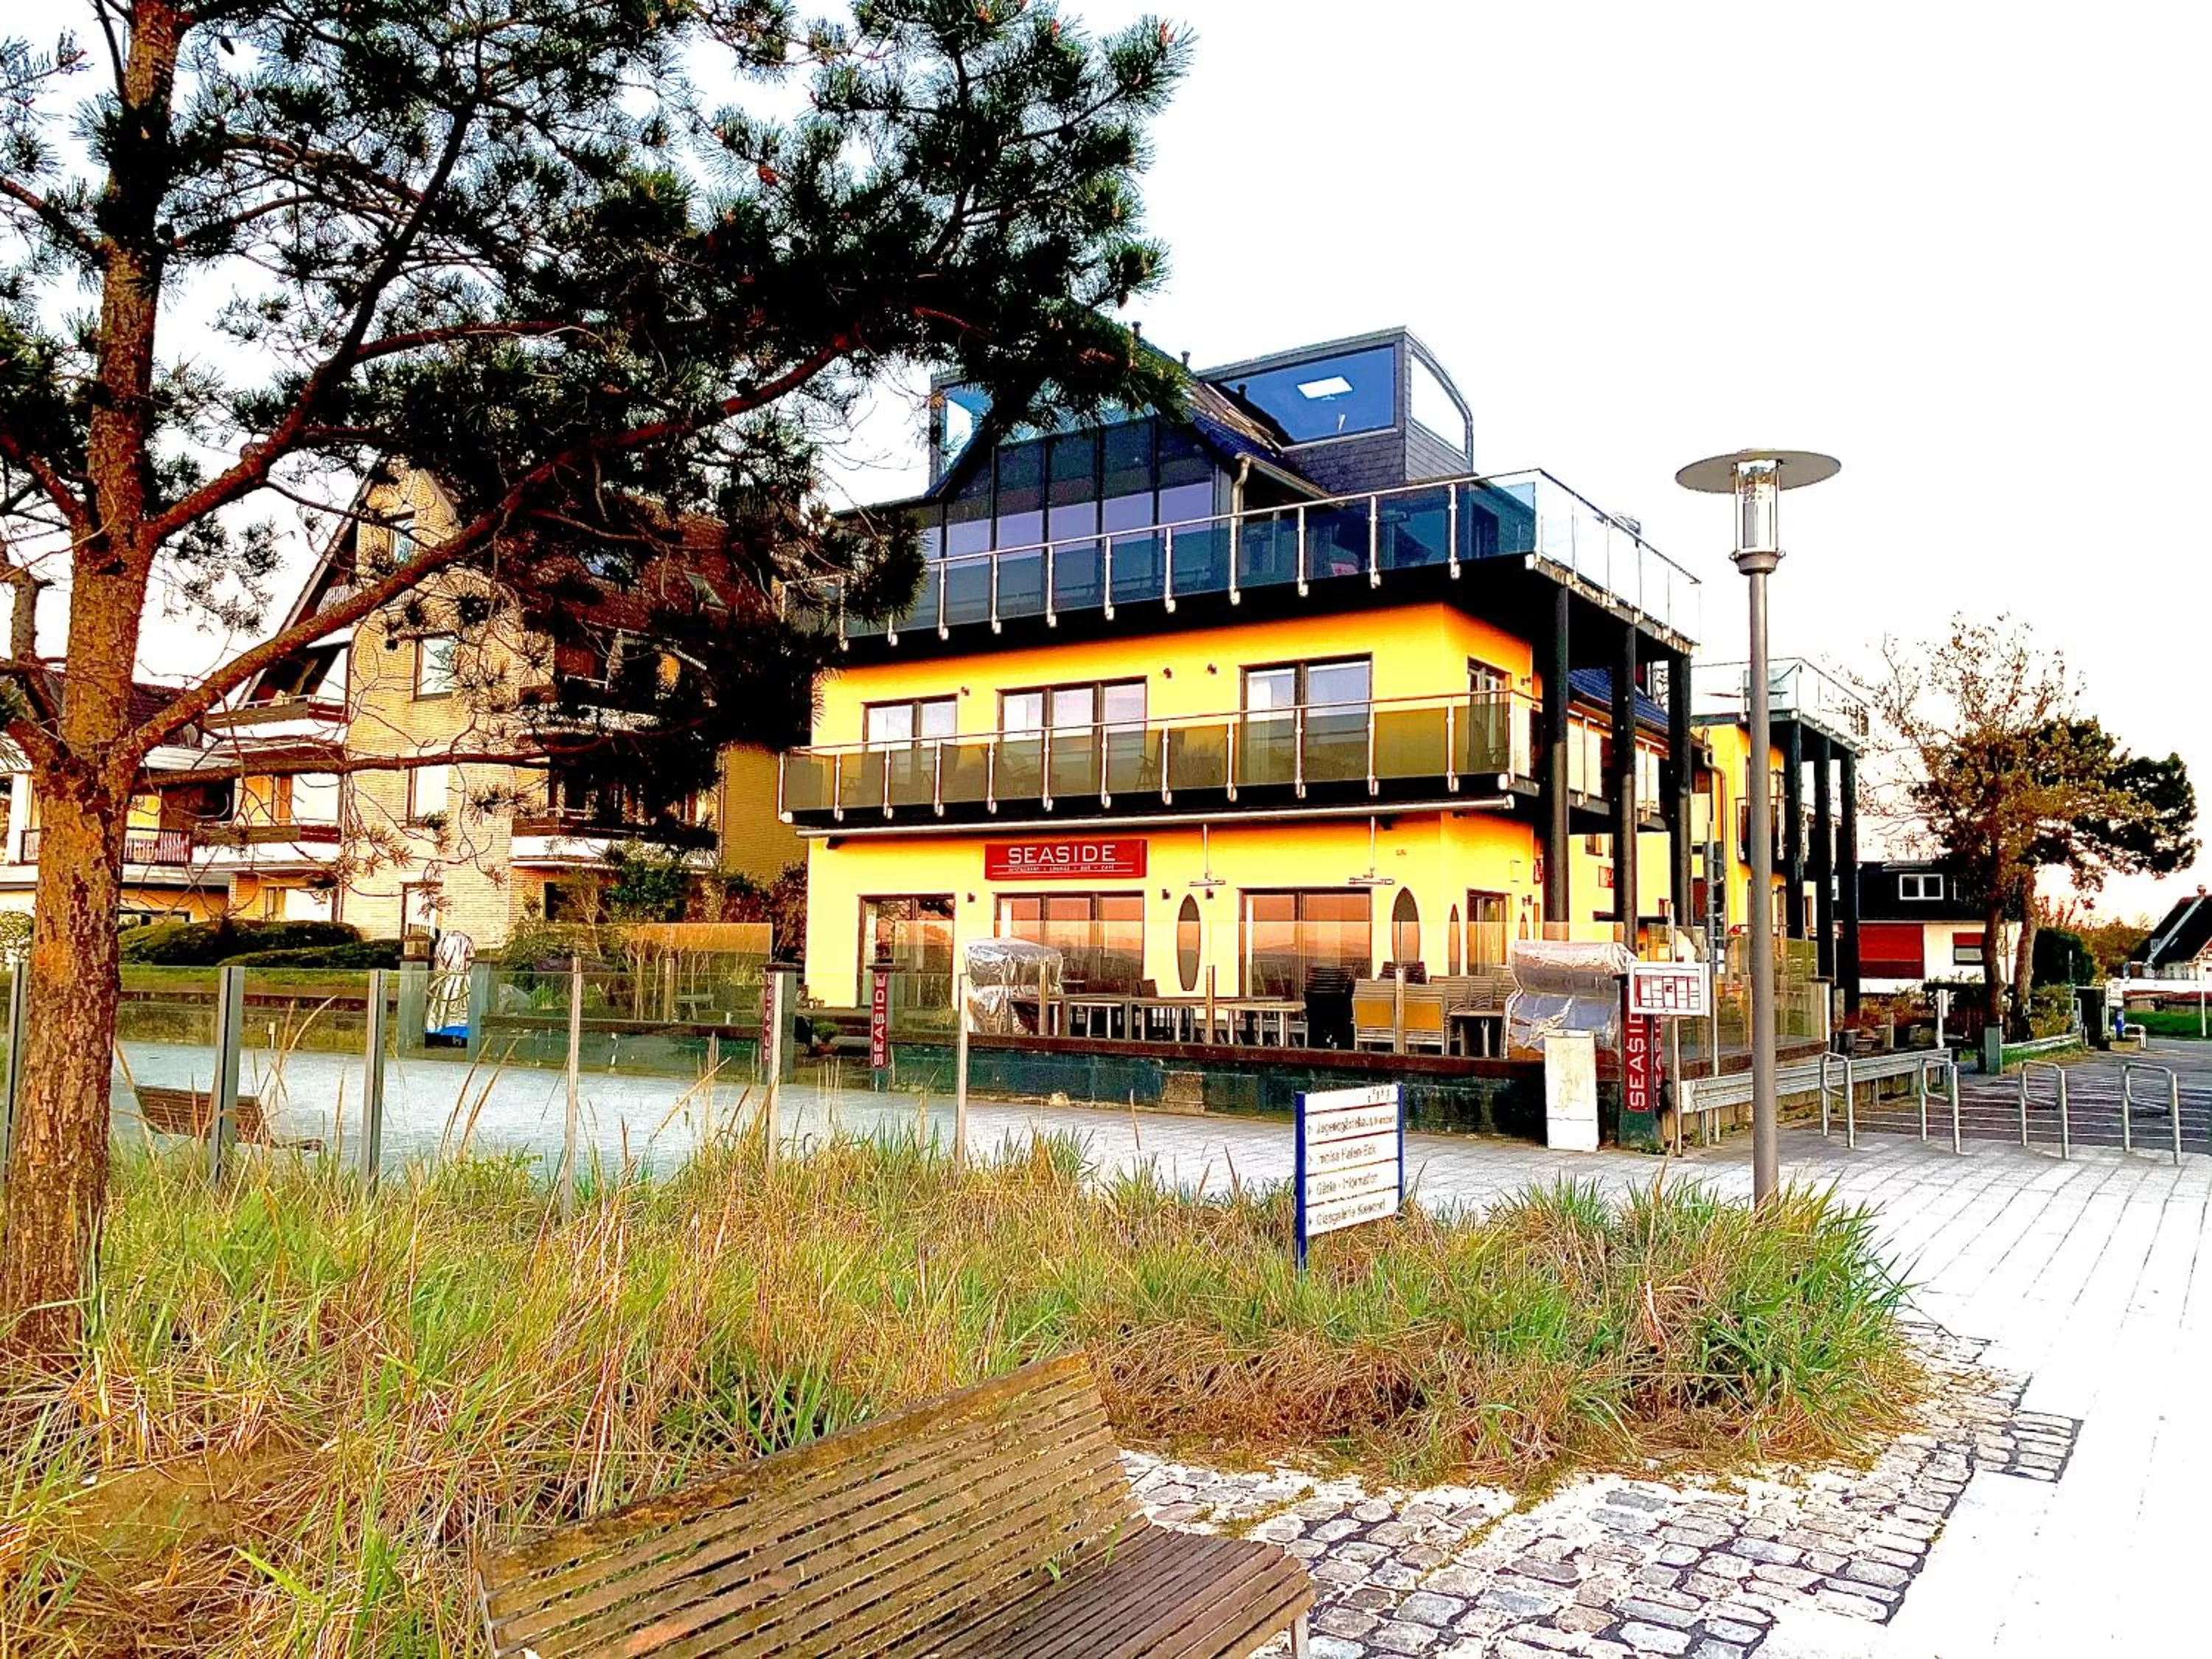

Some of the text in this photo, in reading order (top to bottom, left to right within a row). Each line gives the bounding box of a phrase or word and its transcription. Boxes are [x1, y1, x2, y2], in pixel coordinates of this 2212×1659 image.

[1008, 844, 1116, 864] SEASIDE
[873, 974, 886, 1068] SEASIDE
[1629, 1015, 1645, 1107] SEASI
